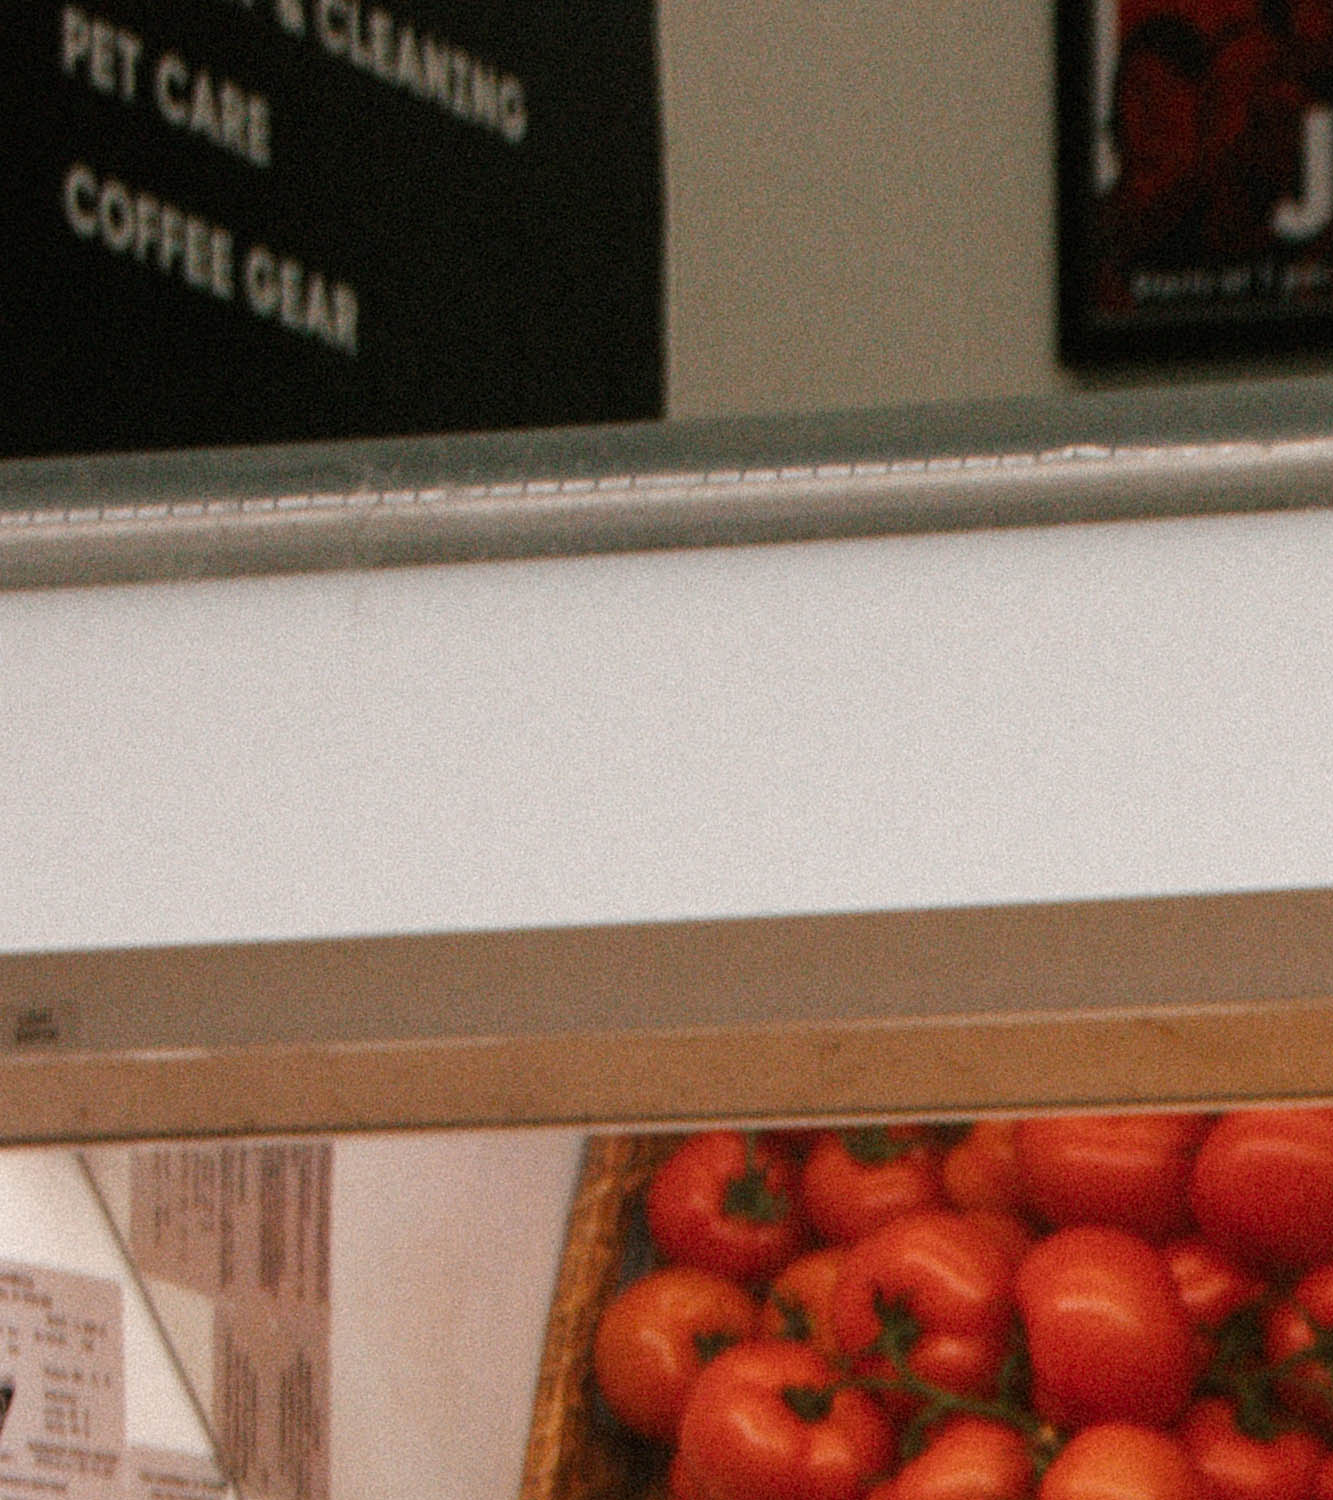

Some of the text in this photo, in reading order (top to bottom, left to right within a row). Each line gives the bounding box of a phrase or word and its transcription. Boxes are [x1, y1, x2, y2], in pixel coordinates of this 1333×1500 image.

[61, 6, 271, 168] PET CARE
[314, 0, 529, 145] CLEANING
[63, 161, 359, 357] COFFEE GEAR
